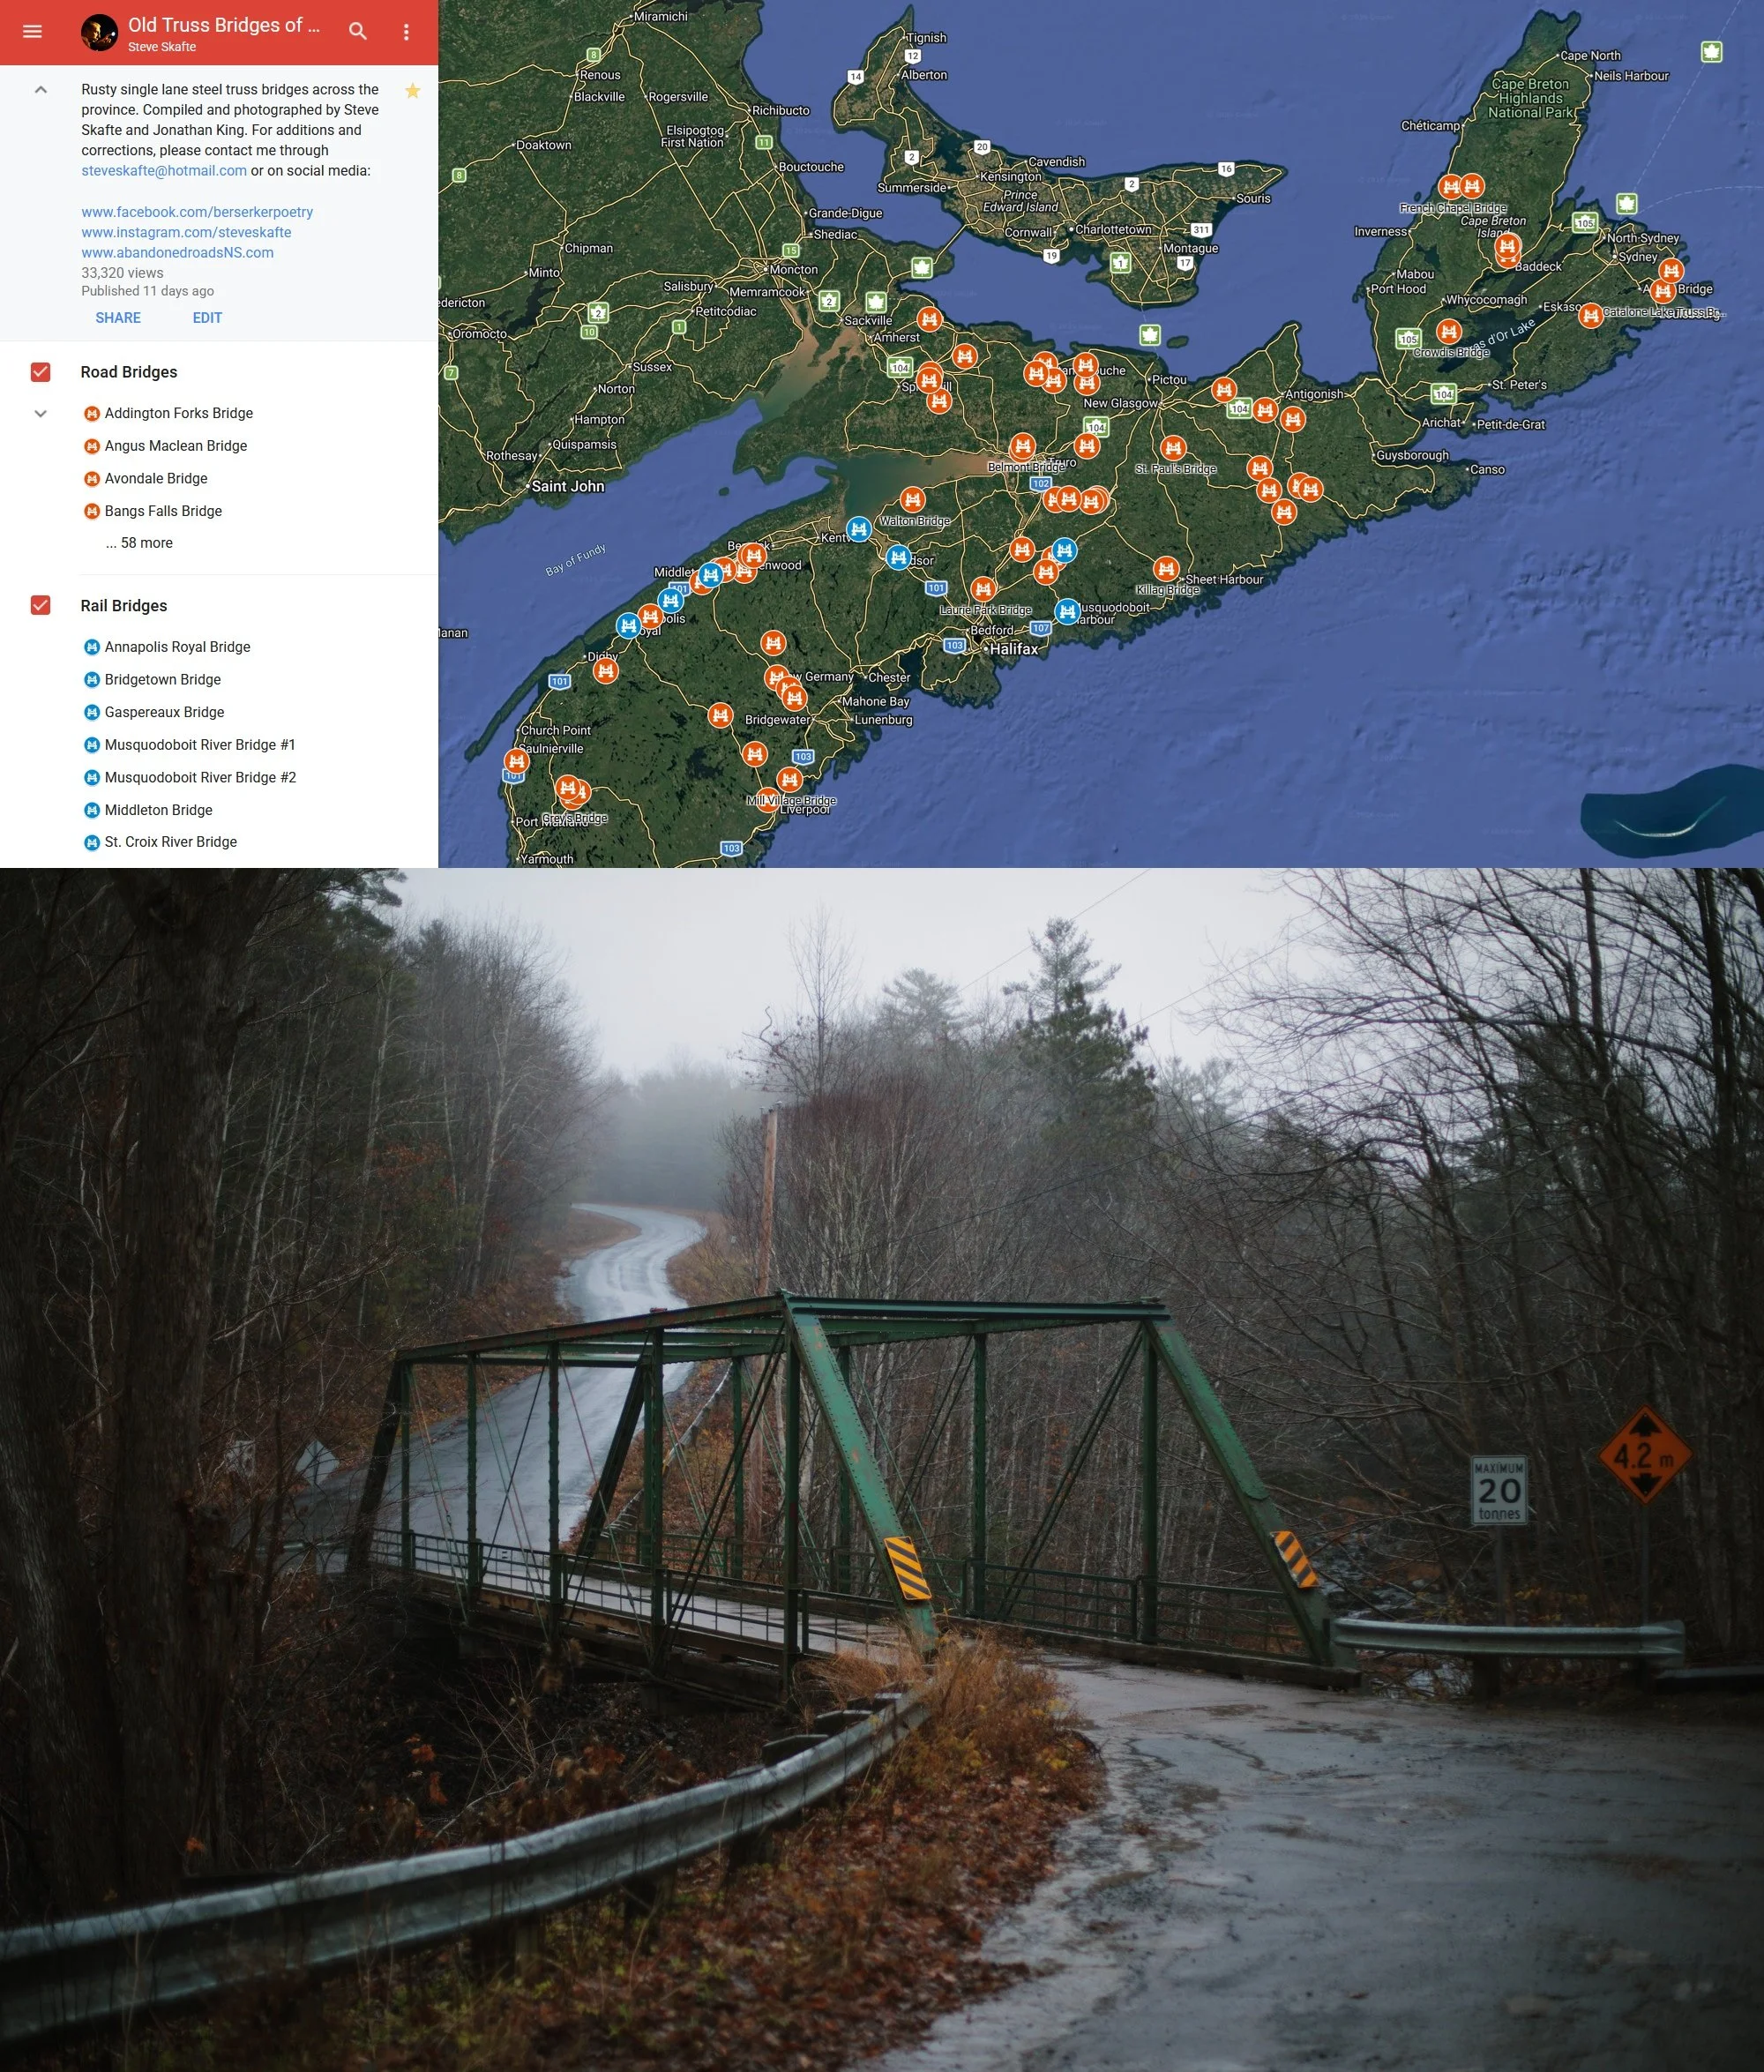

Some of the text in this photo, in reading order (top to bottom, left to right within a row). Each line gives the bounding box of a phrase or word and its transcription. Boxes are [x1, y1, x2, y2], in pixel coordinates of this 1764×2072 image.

[634, 11, 688, 21] Miramichi
[128, 16, 304, 36] Old Truss Bridges of
[907, 33, 946, 44] Tignish
[128, 41, 197, 52] Steve Skafte
[908, 52, 919, 61] 12
[1561, 51, 1621, 62] Cape North
[850, 72, 862, 81] 14
[1595, 71, 1669, 81] Neils Harbour
[81, 83, 379, 98] Rusty single lane steel truss bridges across the
[1492, 79, 1569, 92] Cape Breton
[574, 92, 624, 101] Blackville
[649, 92, 708, 103] Rogersville
[1499, 94, 1563, 106] Highlands
[753, 106, 810, 116] Richibucto
[1489, 108, 1573, 118] National Park
[667, 125, 724, 137] Elsipogtog
[1401, 121, 1460, 133] Chéticamp
[517, 140, 572, 150] Doaktown
[662, 138, 723, 147] First Nation
[976, 142, 988, 152] 20
[81, 144, 329, 159] corrections, please contact me through
[780, 162, 844, 172] Bouctouche
[1029, 157, 1085, 167] Cavendish
[81, 164, 371, 180] steveskafte@hotmail.com or on social media:
[1221, 164, 1232, 173] 16
[981, 172, 1042, 183] Kensington
[878, 183, 946, 192] Summerside
[1004, 190, 1037, 200] Prince
[984, 202, 1058, 213] Edward Island
[1401, 204, 1506, 214] French Chapel Bridge
[81, 206, 314, 221] www.facebook.com/berserkerpoetry
[810, 208, 883, 220] Grande-Digue
[1461, 216, 1526, 227] Cape Breton
[1577, 219, 1595, 228] 105
[81, 226, 292, 241] www.instagram.com/steveskafte
[1005, 228, 1052, 236] Cornwall
[1076, 224, 1151, 235] Charlottetown
[1193, 225, 1209, 235] 311
[1355, 227, 1408, 236] Inverness
[1607, 233, 1679, 245] North Sydney
[81, 246, 274, 258] www.abandonedroadsNS.com
[565, 243, 613, 255] Chipman
[1163, 243, 1219, 255] Montague
[1618, 252, 1657, 264] Sydney
[81, 266, 164, 281] 33,320 views
[771, 265, 818, 274] Moncton
[81, 284, 215, 299] Published 11 days ago
[664, 282, 714, 293] Salisbury
[730, 288, 804, 297] Memramcook
[1447, 295, 1527, 307] Whycocomagh
[95, 311, 142, 324] SHARE
[193, 311, 223, 324] EDIT
[696, 307, 756, 317] Petitcodiac
[845, 316, 892, 325] Sackville
[453, 329, 507, 340] Oromocto
[874, 333, 920, 342] Amherst
[80, 364, 178, 382] Road Bridges
[892, 364, 908, 373] 104
[1153, 375, 1186, 385] Pictou
[1492, 380, 1547, 390] St. Peter's
[1286, 390, 1343, 400] Antigonish
[1084, 399, 1157, 410] New Glasgow
[104, 407, 254, 422] Addington Forks Bridge
[1477, 420, 1545, 429] Petit-de-Grat
[553, 440, 617, 451] Quispamsis
[486, 451, 537, 462] Rothesay
[1377, 451, 1449, 462] Guysborough
[1136, 465, 1216, 476] St. Paul's Bridge
[533, 481, 604, 491] Saint John
[881, 517, 950, 528] Walton Bridge
[121, 536, 174, 549] 58 more
[546, 543, 606, 576] Bay of Fundy
[80, 598, 168, 616] Rail Bridges
[971, 625, 1013, 635] Bedford
[1033, 624, 1050, 632] 107
[104, 640, 251, 655] Annapolis Royal Bridge
[990, 644, 1038, 655] Halifax
[551, 677, 568, 686] 101
[843, 697, 909, 708] Mahone Bay
[745, 715, 811, 727] Bridgewater
[855, 715, 912, 727] Lunenburg
[522, 726, 591, 736] Church Point
[105, 738, 295, 753] Musquodoboit River Bridge #1
[105, 804, 213, 819] Middleton Bridge
[104, 835, 238, 850] St. Croix River Bridge
[724, 844, 740, 853] 103
[521, 855, 573, 864] Yarmouth
[1614, 1443, 1673, 1469] 4.2 m
[1475, 1462, 1524, 1474] MAXIMUM
[1479, 1478, 1521, 1503] 20
[1479, 1508, 1521, 1520] tonnes
